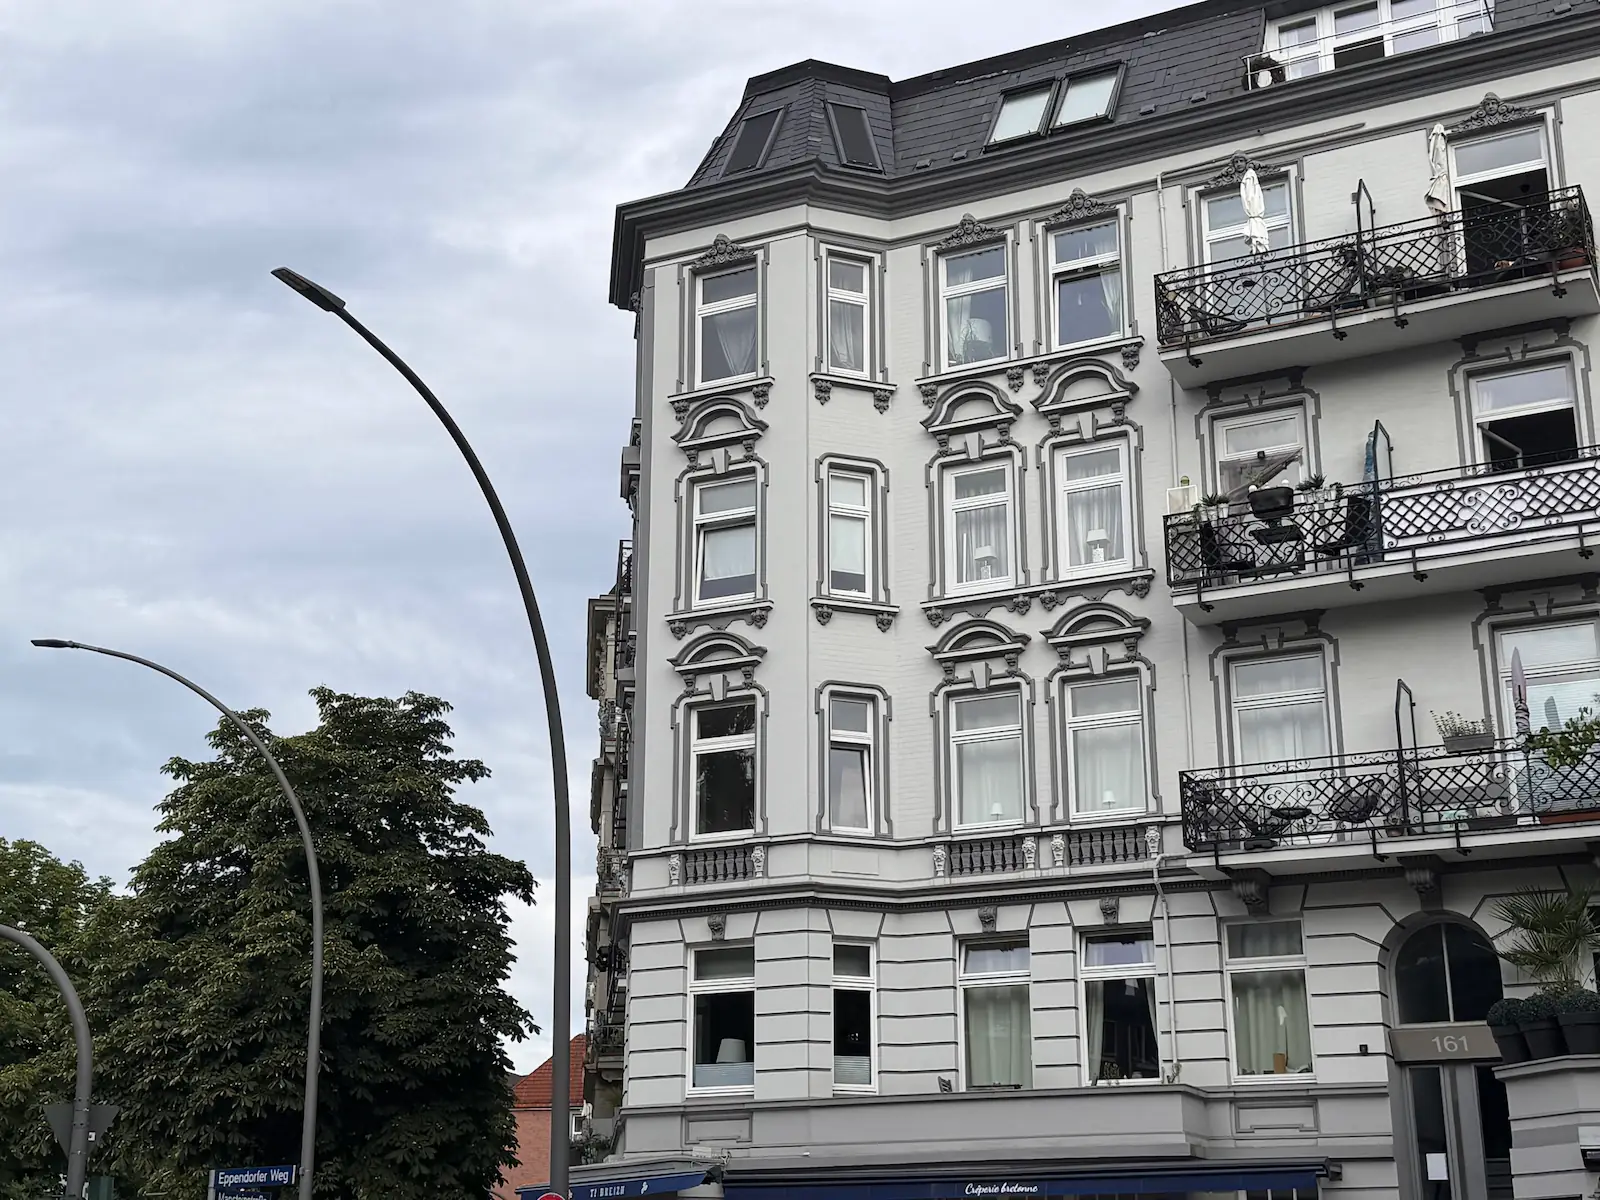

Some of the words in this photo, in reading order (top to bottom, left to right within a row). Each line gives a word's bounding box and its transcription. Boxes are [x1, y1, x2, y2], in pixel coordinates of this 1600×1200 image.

[1431, 1035, 1469, 1053] 161
[218, 1170, 268, 1187] Eppendorfer
[270, 1169, 289, 1184] Weg
[1000, 1182, 1038, 1193] bretonne
